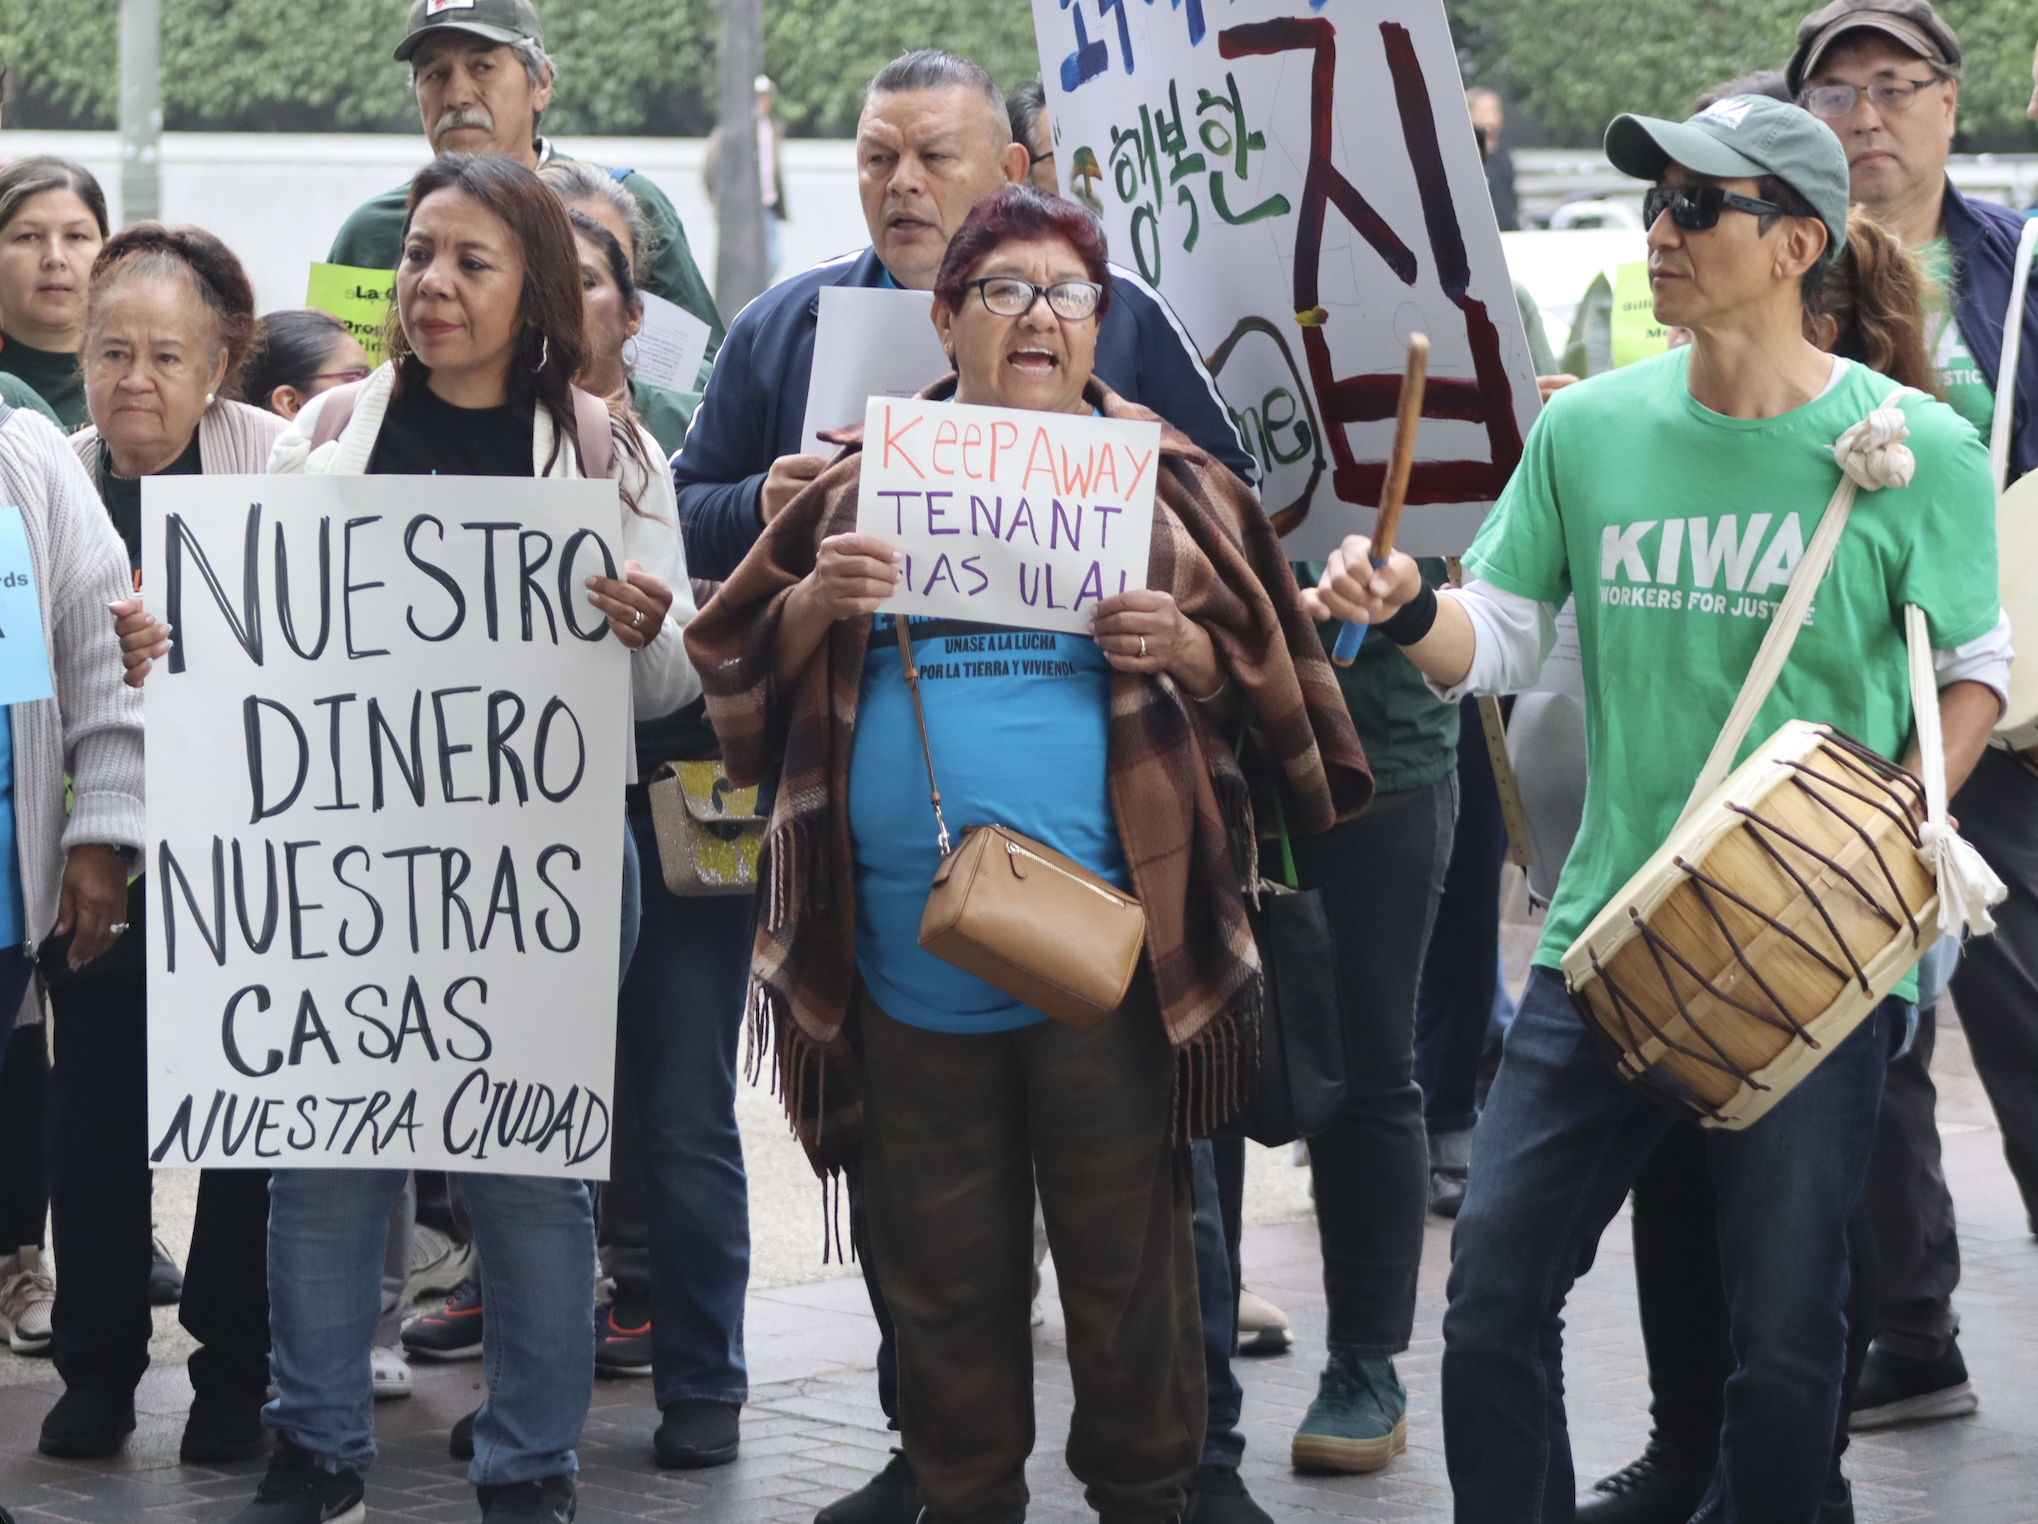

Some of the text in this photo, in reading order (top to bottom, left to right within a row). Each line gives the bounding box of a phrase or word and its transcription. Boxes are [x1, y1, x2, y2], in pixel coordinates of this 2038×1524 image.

[1109, 71, 1291, 288] 행복한
[356, 285, 379, 299] La
[1218, 16, 1526, 508] 집
[1622, 300, 1653, 311] Billi
[1022, 426, 1152, 501] AWAY
[1228, 386, 1312, 473] me
[877, 491, 1123, 551] TENANT
[1601, 511, 1806, 594] KIWA
[0, 571, 29, 588] ds
[165, 503, 618, 674] NUESTRO
[1600, 586, 1815, 626] WORKERS FOR JUSTE
[920, 659, 1076, 680] POR LA TIERRA Y VIVIENDA
[988, 634, 995, 652] A
[998, 634, 1013, 651] LA
[1015, 634, 1057, 651] LUCHA
[242, 685, 585, 824] DINERO
[159, 834, 581, 973] NUESTRAS
[221, 975, 493, 1077] CASAS
[149, 1067, 609, 1166] NUESTRA CIUDAD
